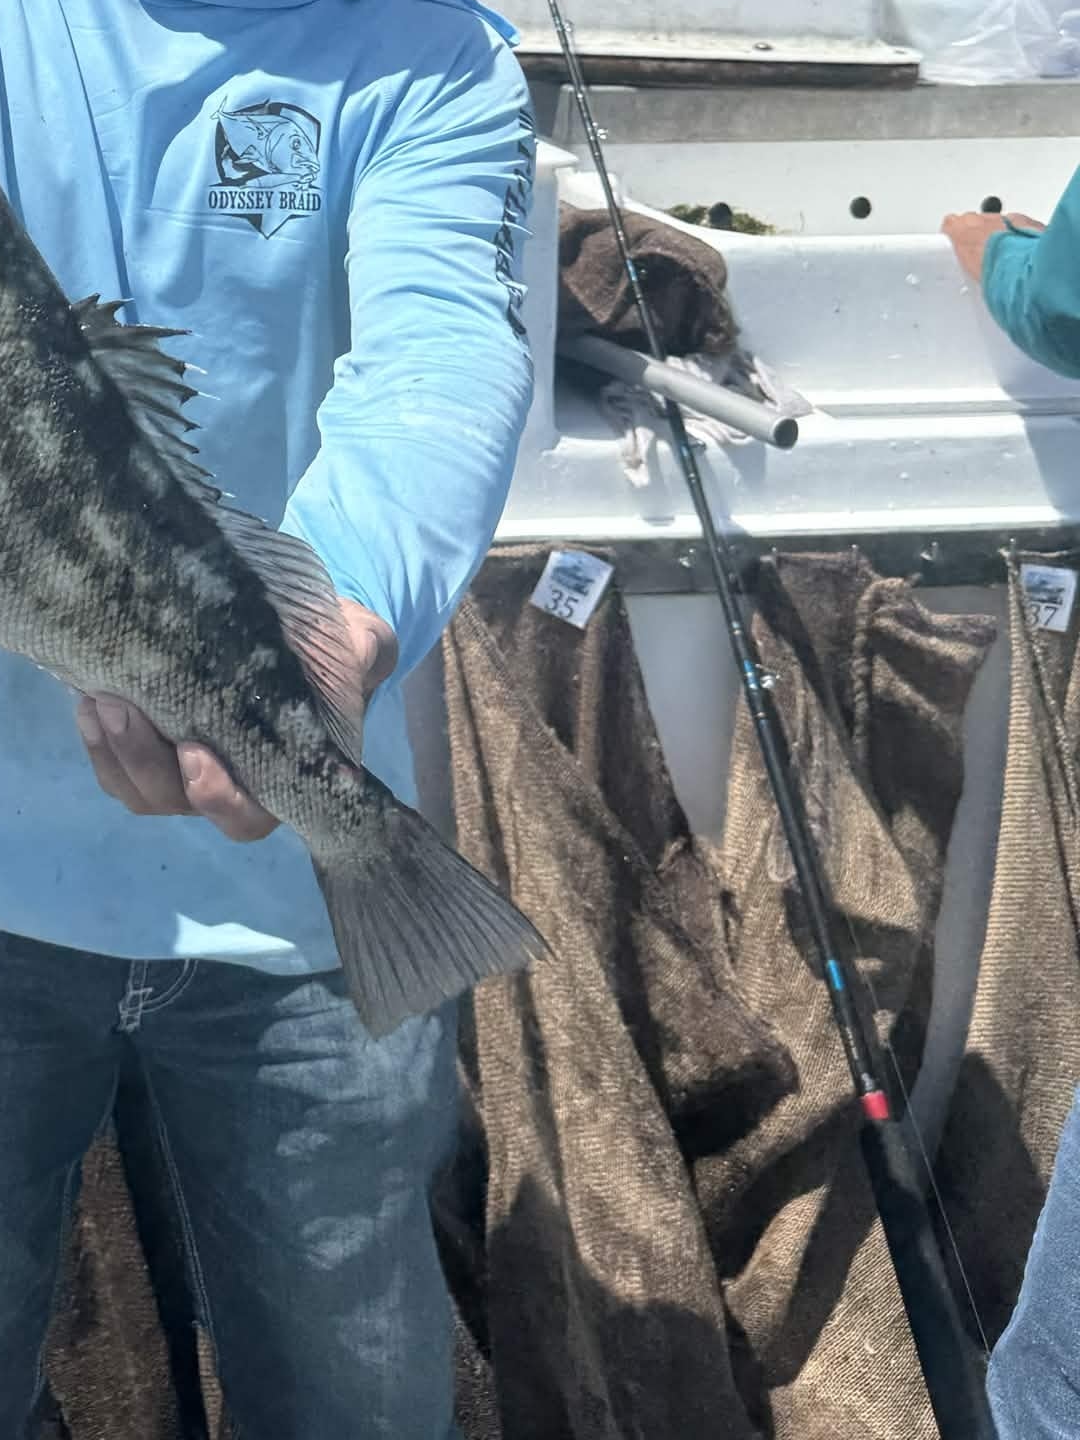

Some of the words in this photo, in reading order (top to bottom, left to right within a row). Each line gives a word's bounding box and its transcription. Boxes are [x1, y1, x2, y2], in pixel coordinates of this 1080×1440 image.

[208, 190, 274, 210] ODYSSEY
[280, 191, 321, 211] BRAID
[544, 589, 579, 618] 35
